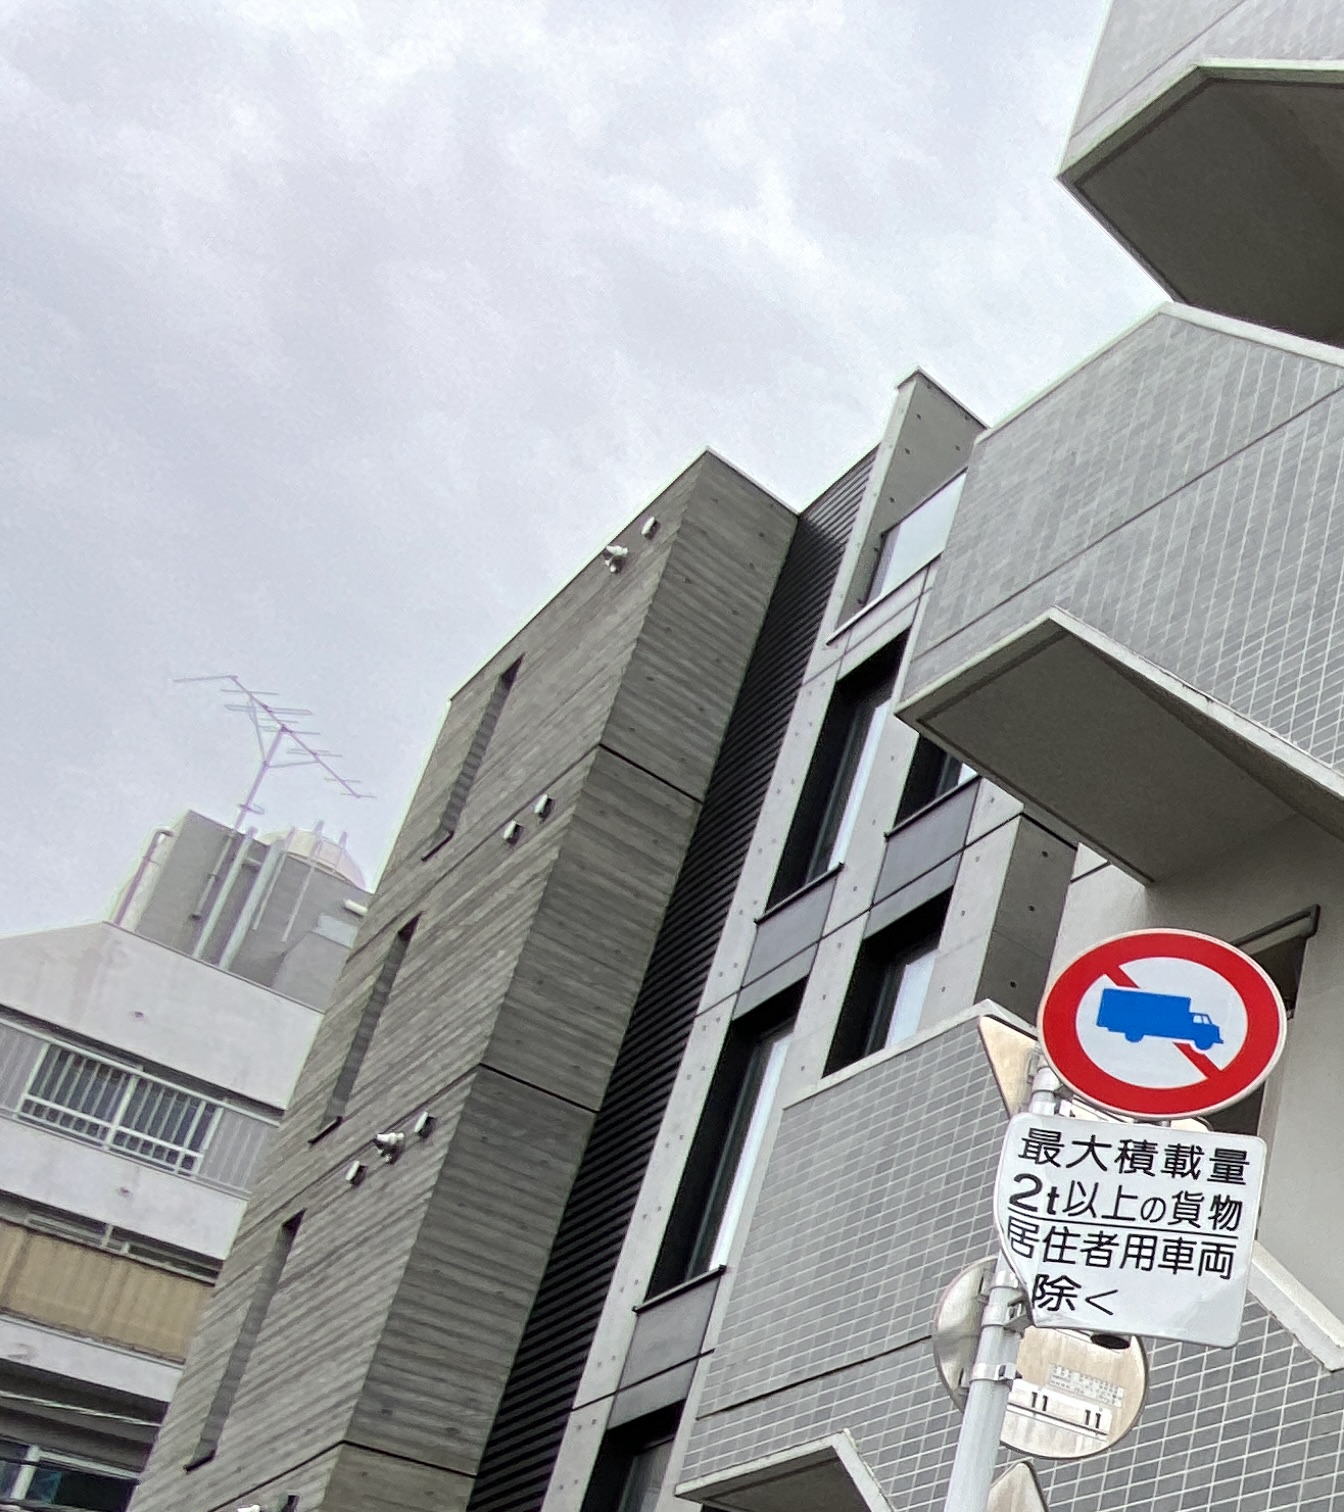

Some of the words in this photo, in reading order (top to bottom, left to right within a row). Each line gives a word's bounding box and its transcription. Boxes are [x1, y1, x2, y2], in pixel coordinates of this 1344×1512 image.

[1018, 1127, 1250, 1186] 最大積載量
[1008, 1173, 1243, 1231] 2t以上の貨物
[1007, 1215, 1238, 1280] 居住者用車両
[1031, 1274, 1119, 1316] 除く
